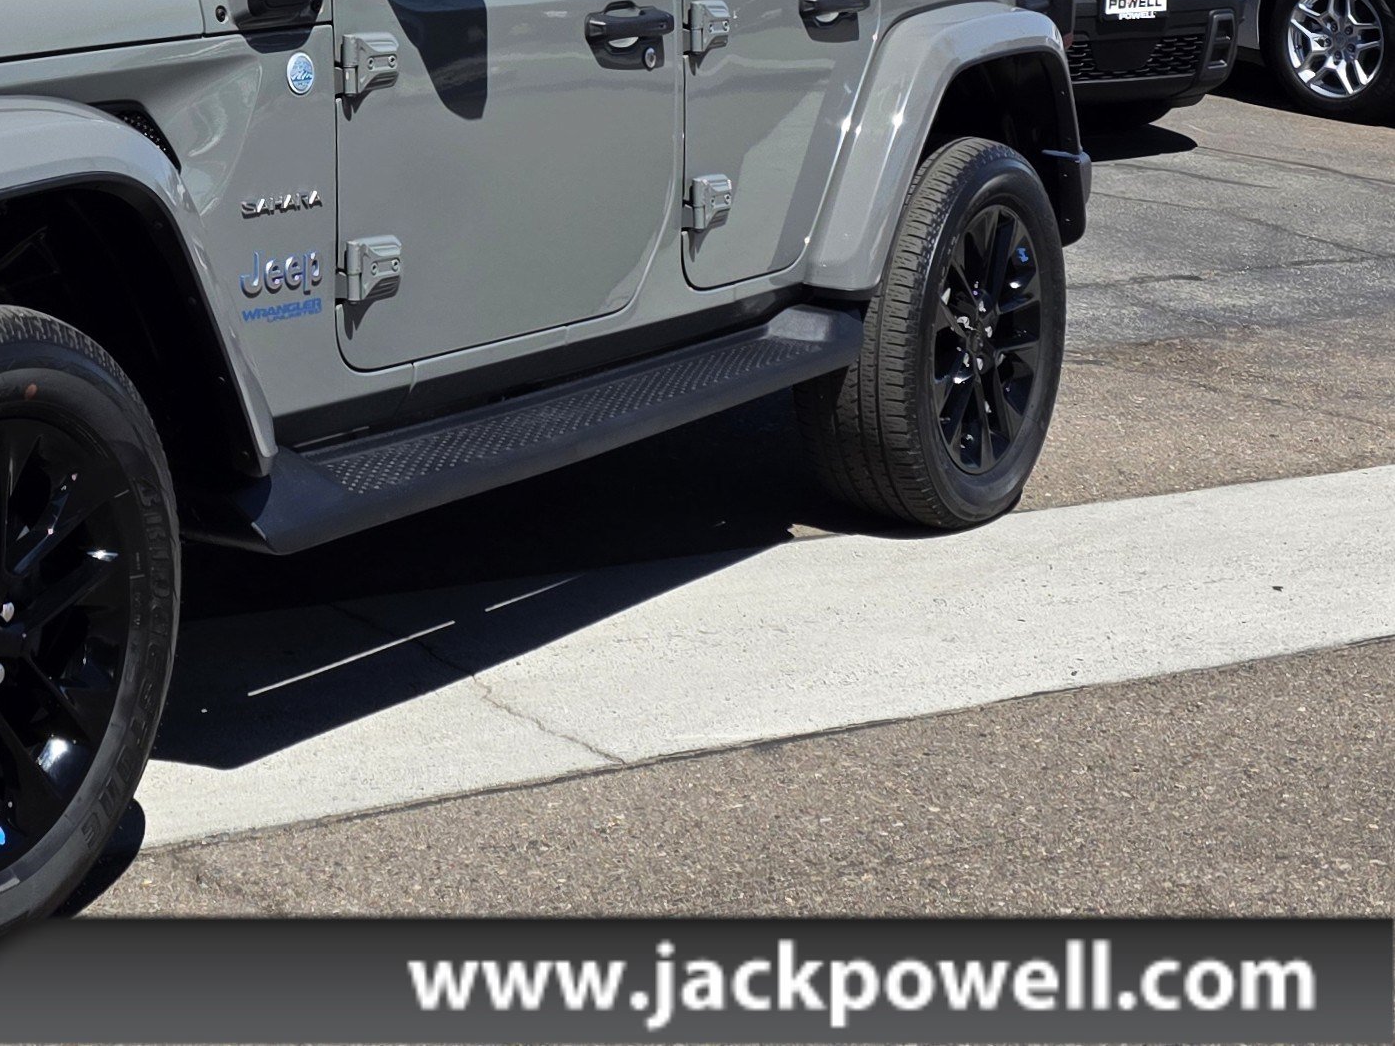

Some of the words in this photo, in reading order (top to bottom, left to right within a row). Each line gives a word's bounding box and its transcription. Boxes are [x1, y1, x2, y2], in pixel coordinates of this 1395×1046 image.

[240, 190, 323, 219] SAHARA
[239, 250, 323, 299] Jeep
[242, 297, 322, 322] WRANGLER
